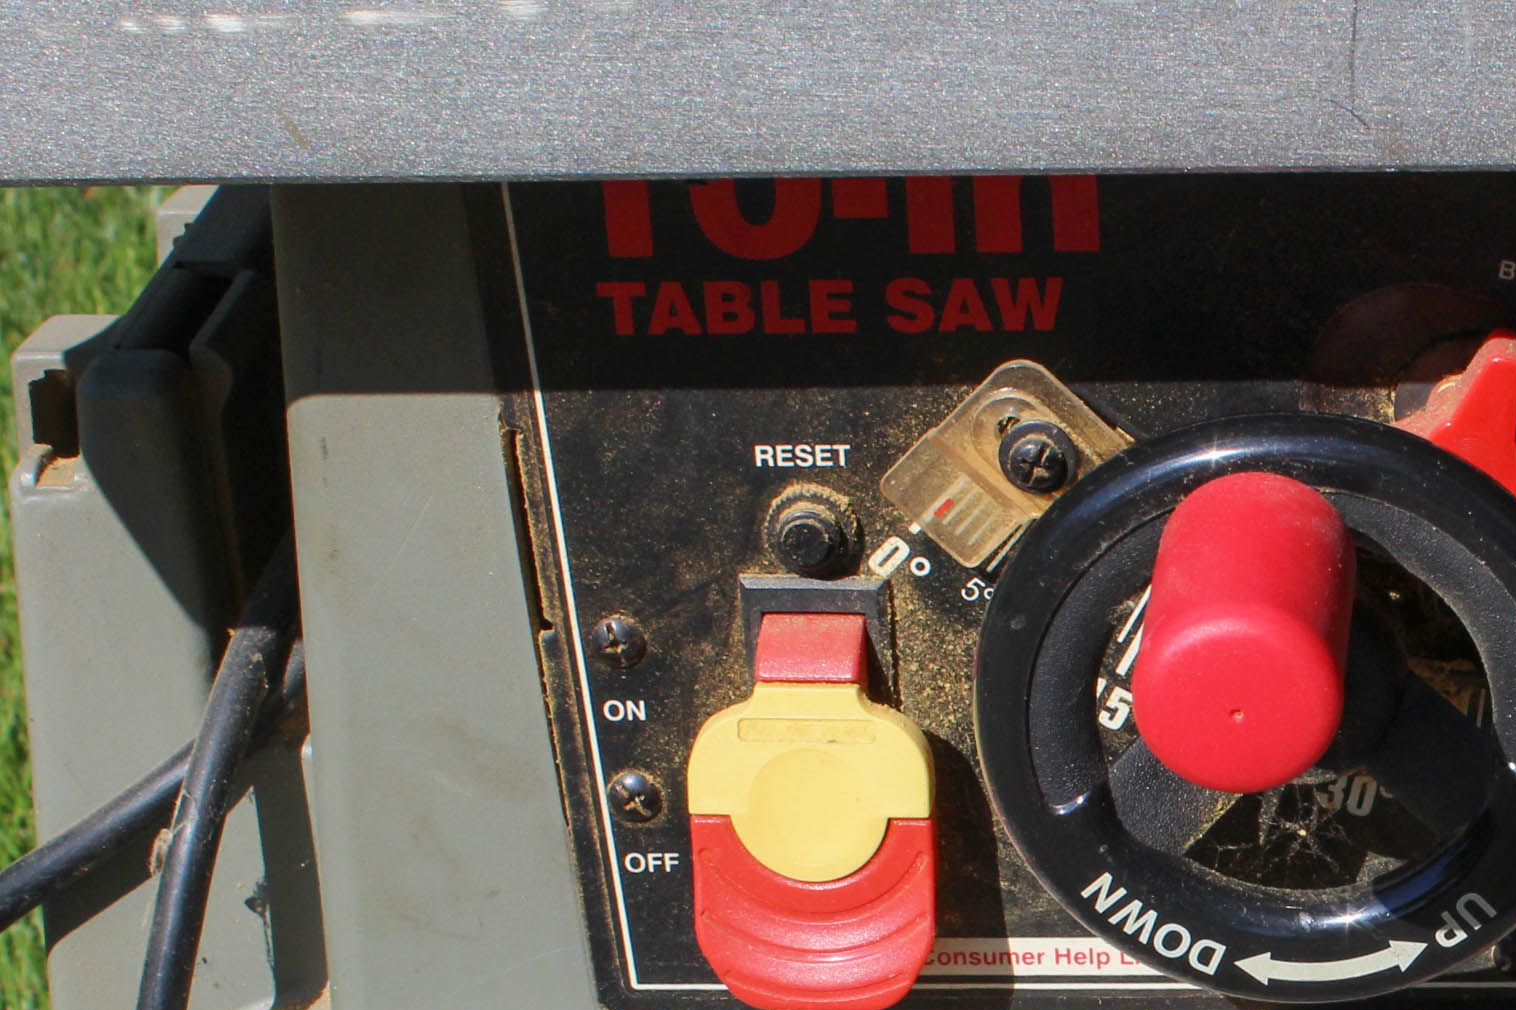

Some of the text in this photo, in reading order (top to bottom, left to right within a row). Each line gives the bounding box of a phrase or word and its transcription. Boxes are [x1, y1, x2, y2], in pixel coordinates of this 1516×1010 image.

[597, 277, 1064, 336] TABLE SAW
[754, 444, 852, 468] RESET
[602, 699, 647, 723] ON
[624, 853, 680, 874] OFF
[1080, 871, 1227, 977] DOWN
[1434, 891, 1498, 950] UP
[1054, 947, 1111, 970] Help
